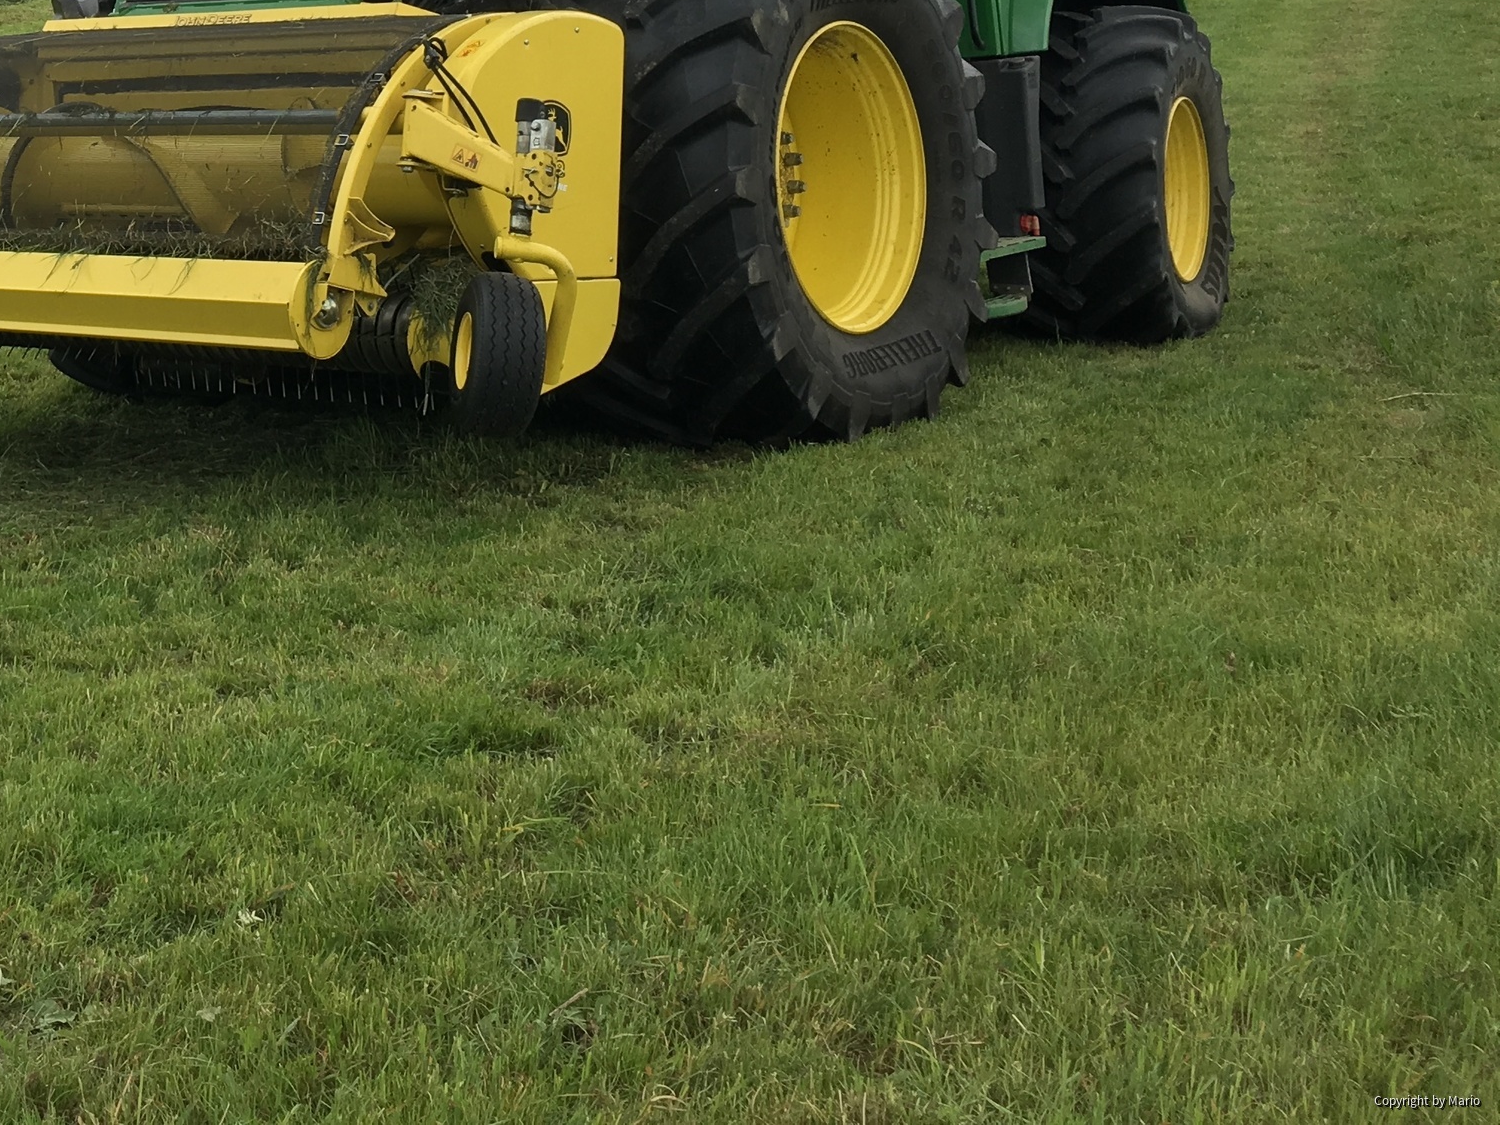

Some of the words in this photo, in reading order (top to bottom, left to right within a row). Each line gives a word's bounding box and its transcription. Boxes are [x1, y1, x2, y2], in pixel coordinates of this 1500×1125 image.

[173, 15, 207, 27] JOHN
[207, 13, 253, 26] DEERE
[841, 329, 942, 379] TRELLEBORG
